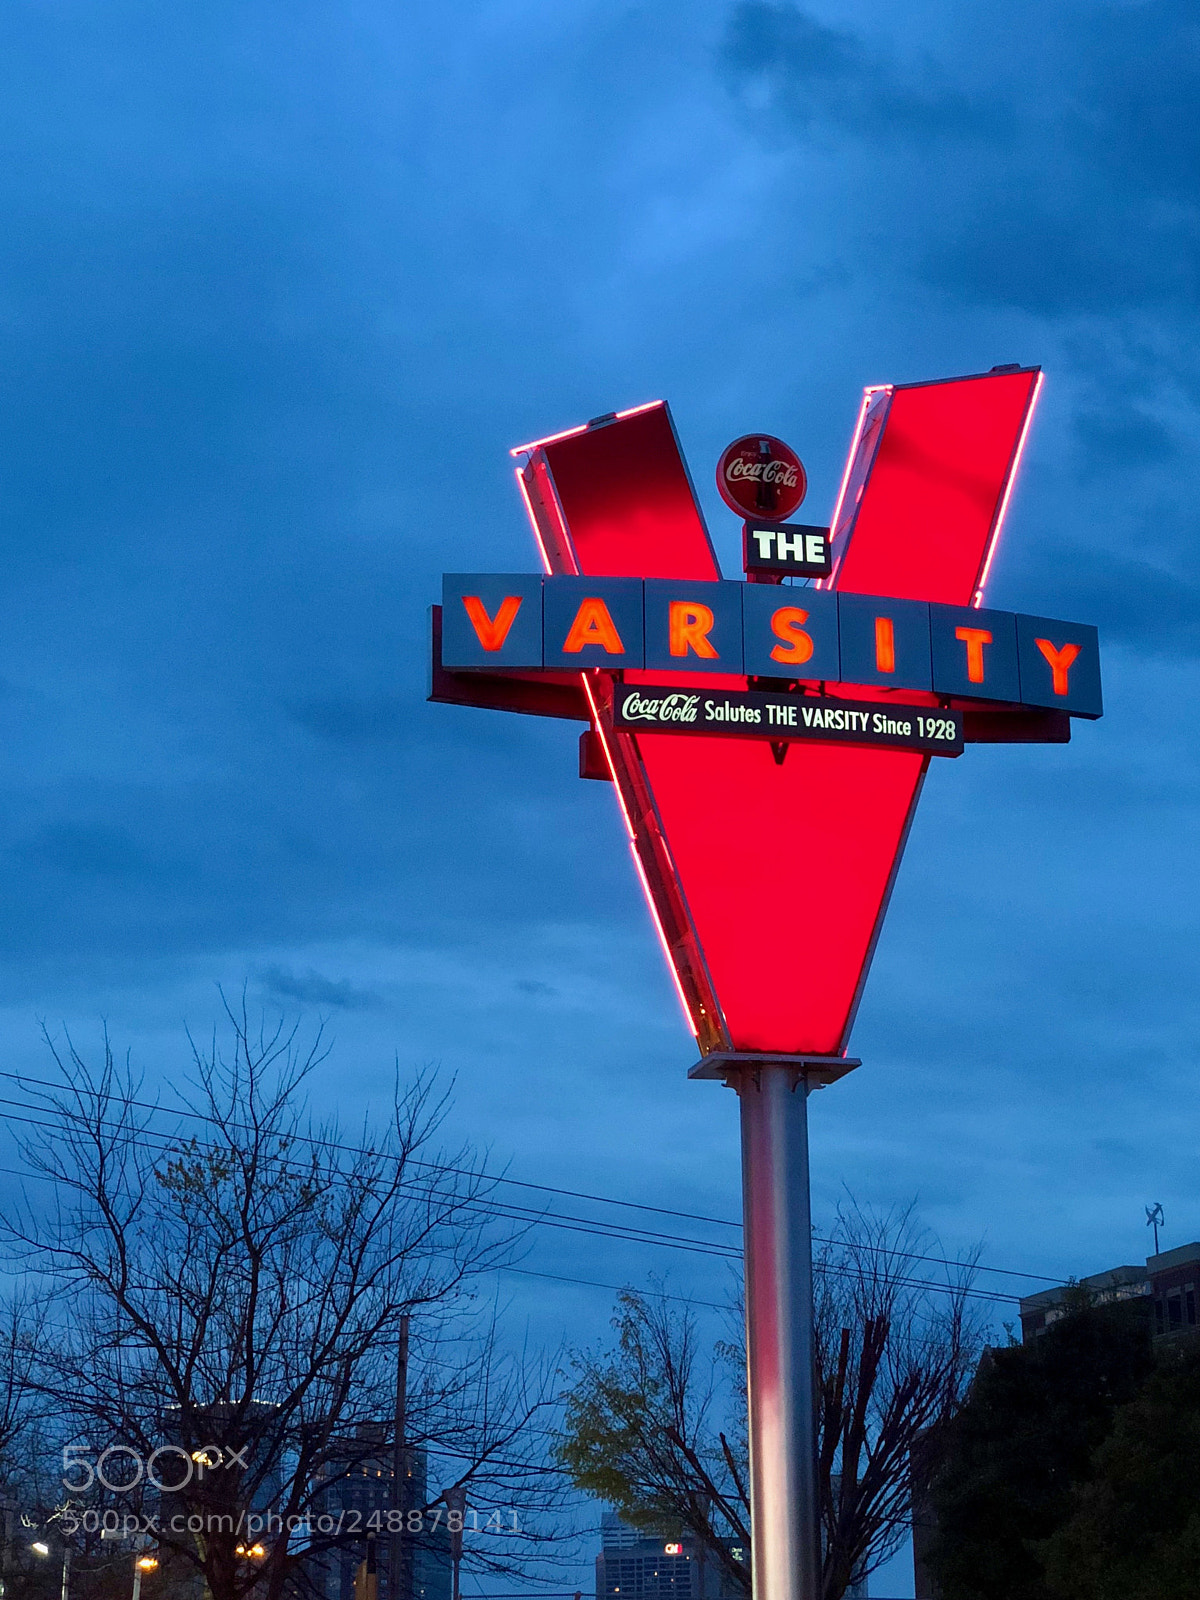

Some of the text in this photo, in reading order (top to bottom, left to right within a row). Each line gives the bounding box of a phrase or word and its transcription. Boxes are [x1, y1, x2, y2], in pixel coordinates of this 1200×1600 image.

[752, 530, 826, 564] THE
[461, 595, 1083, 696] VARSITY
[704, 700, 762, 724] Salutes
[765, 704, 798, 726] THE
[801, 707, 870, 732] VARSITY
[872, 713, 912, 736] Since
[916, 716, 956, 741] 1928
